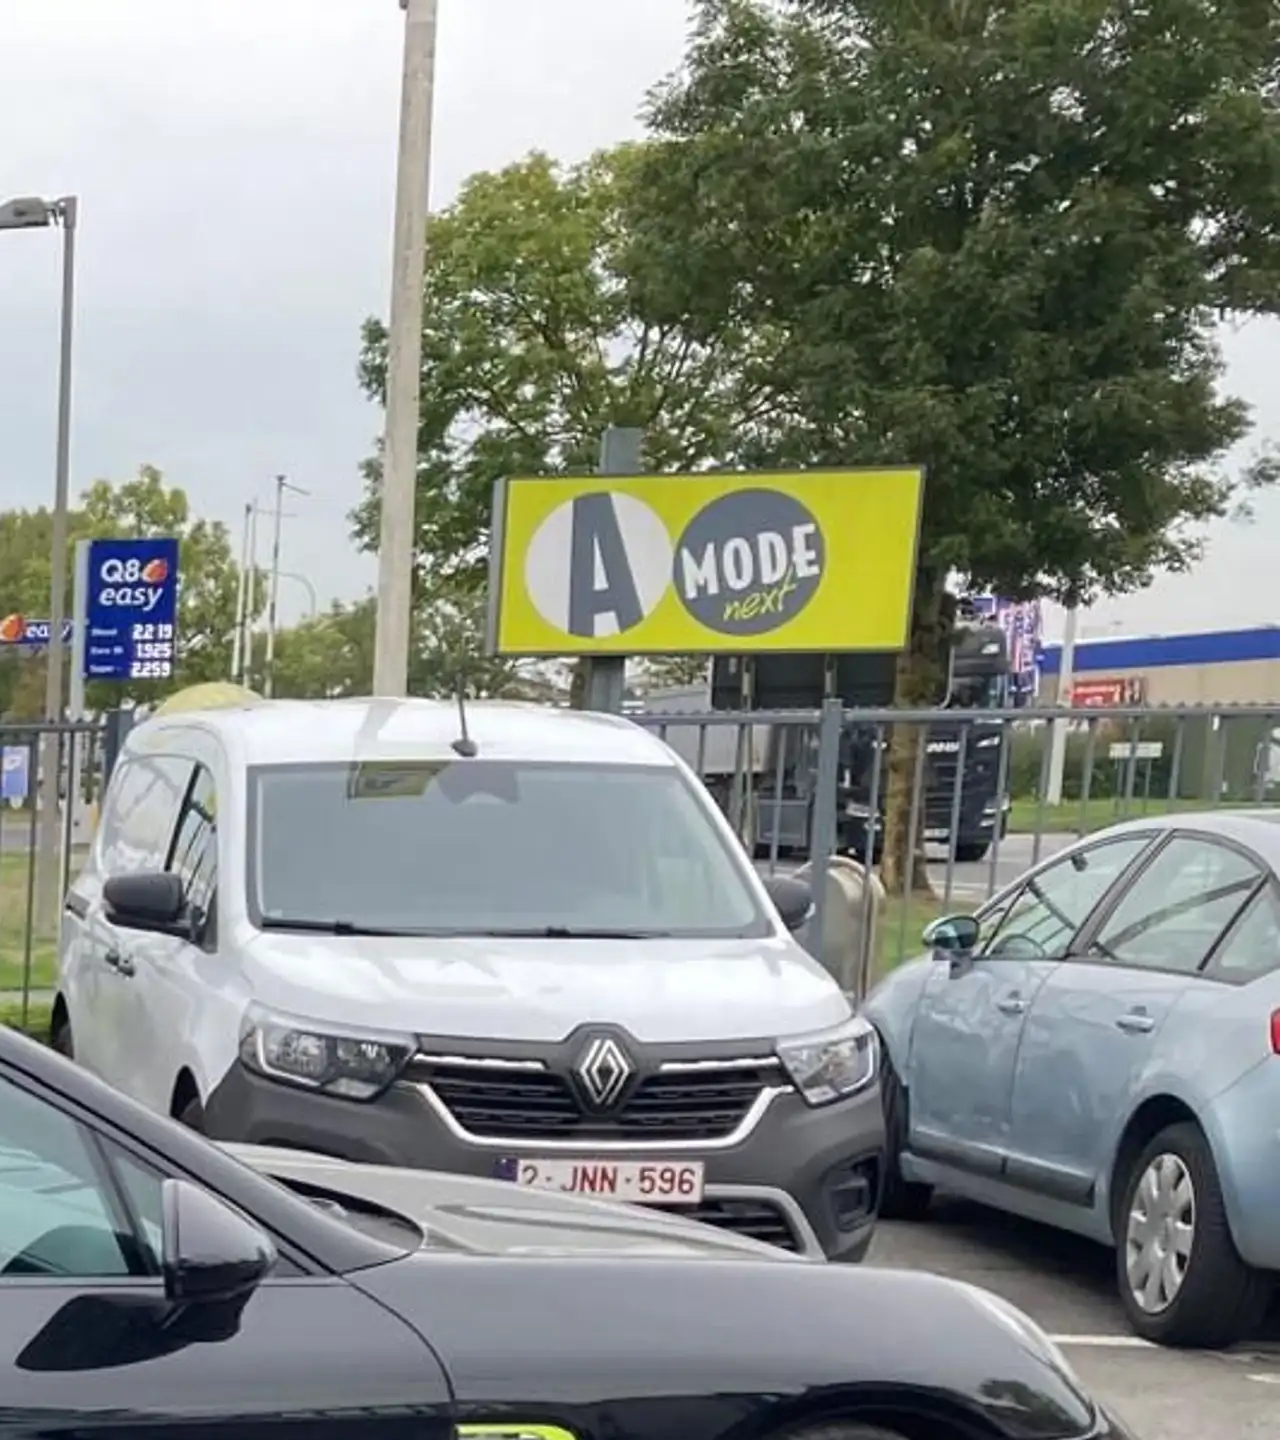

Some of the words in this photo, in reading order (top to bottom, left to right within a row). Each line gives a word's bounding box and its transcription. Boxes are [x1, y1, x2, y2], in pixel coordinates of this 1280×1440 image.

[101, 558, 140, 582] Q8
[568, 491, 644, 638] A
[680, 523, 820, 600] MODE
[99, 587, 164, 612] easy
[722, 571, 798, 622] next
[26, 624, 71, 641] eay
